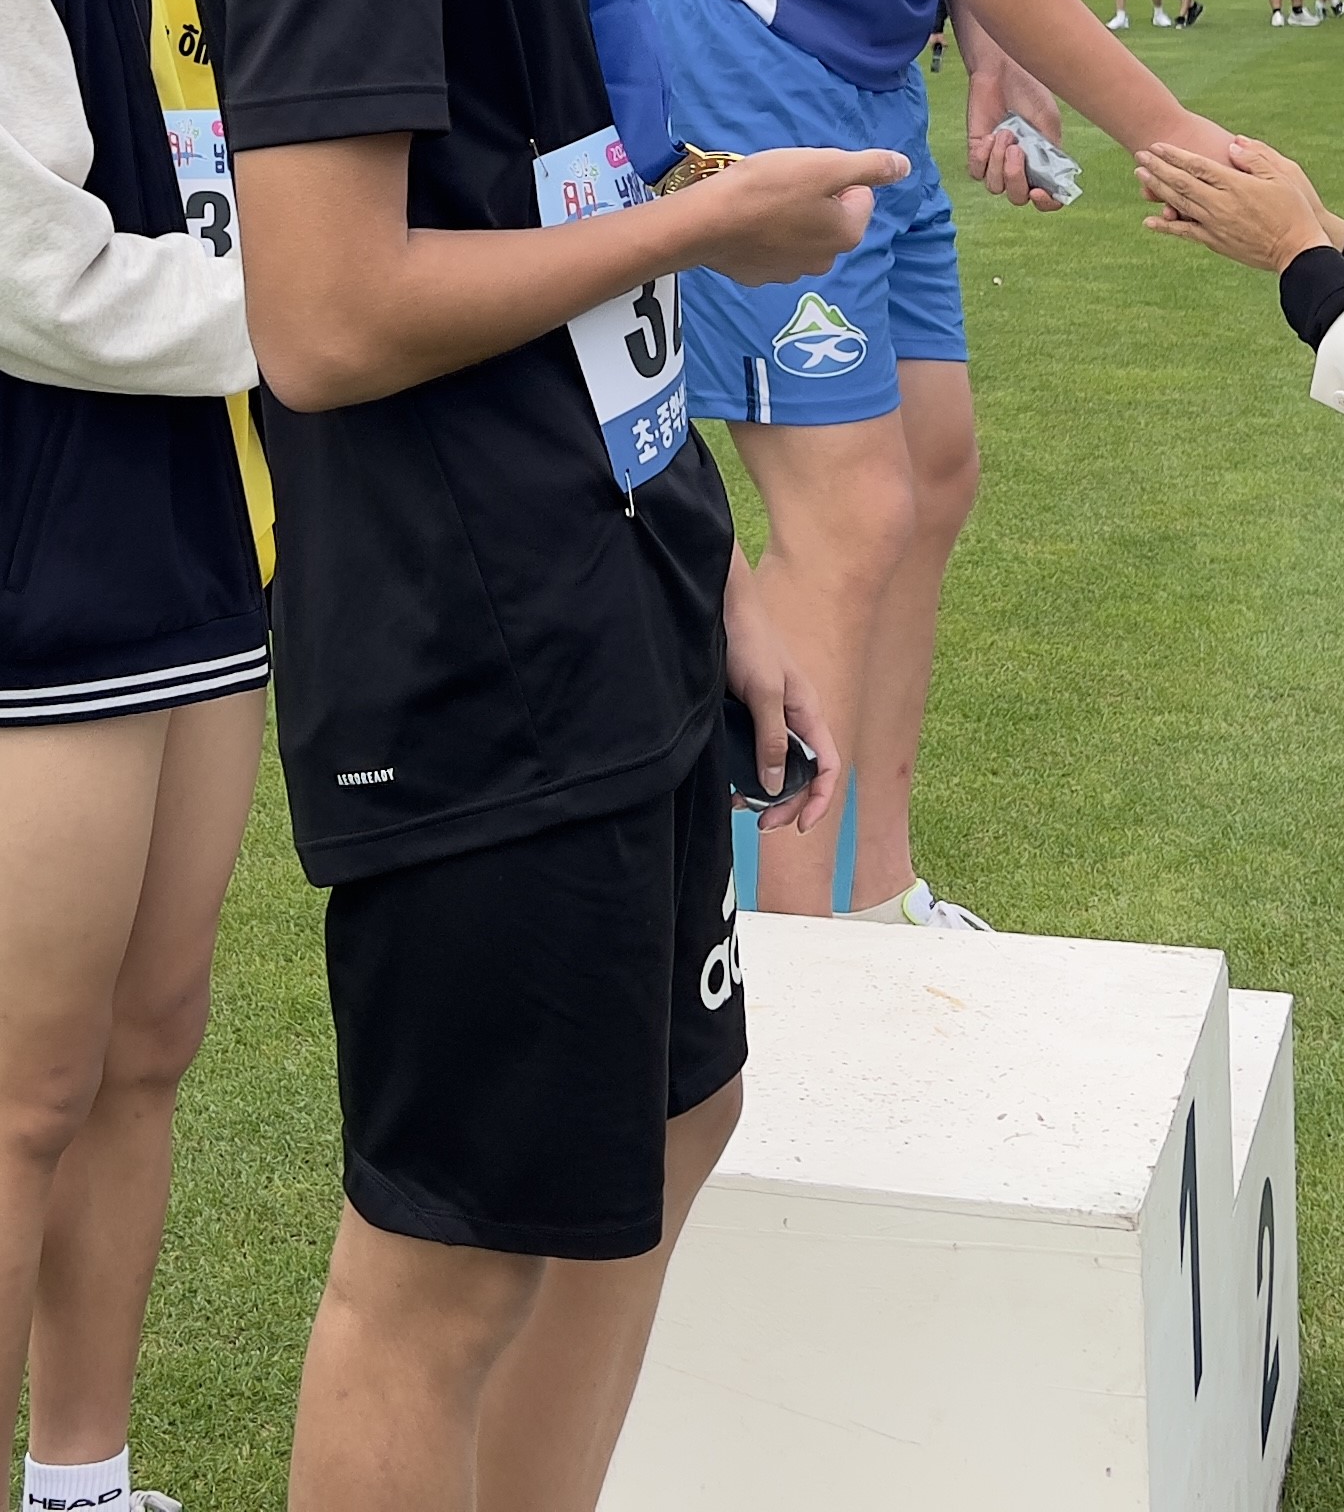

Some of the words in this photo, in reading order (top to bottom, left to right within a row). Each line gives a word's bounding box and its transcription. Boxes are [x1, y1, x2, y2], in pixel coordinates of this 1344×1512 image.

[165, 24, 211, 66] 해
[337, 767, 395, 785] AEROREADY
[1180, 1096, 1203, 1403] 1
[1256, 1176, 1280, 1461] 2
[29, 1488, 123, 1511] HEAD
